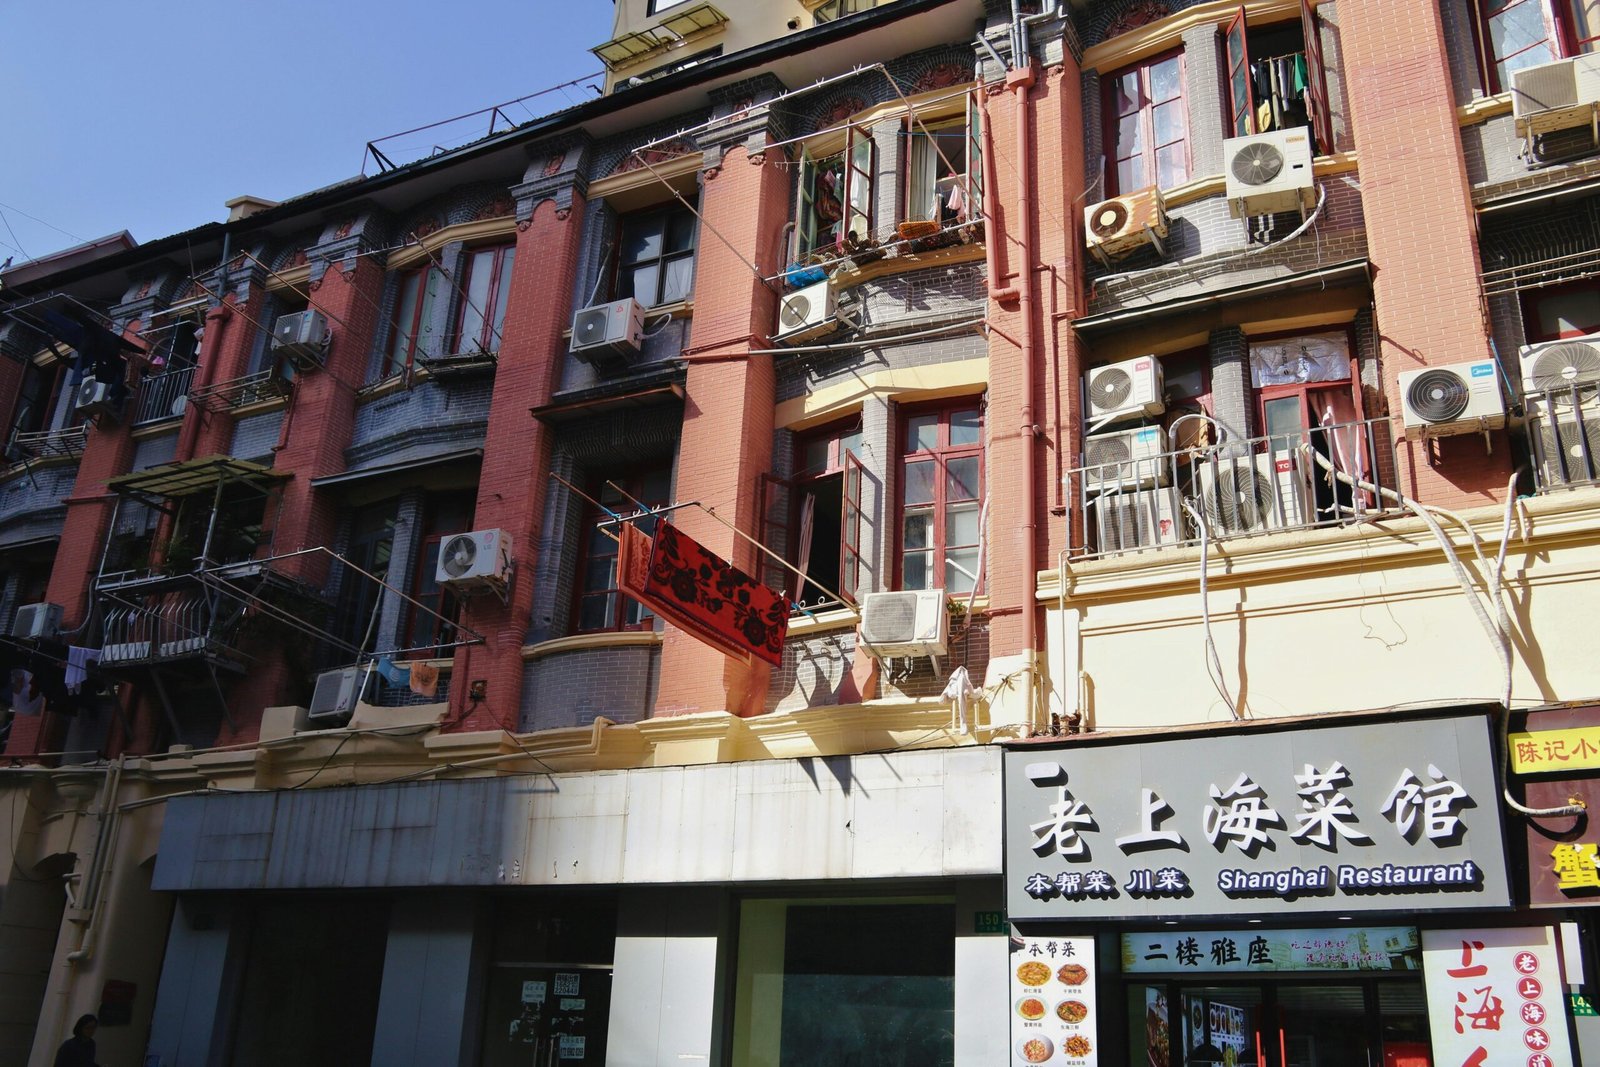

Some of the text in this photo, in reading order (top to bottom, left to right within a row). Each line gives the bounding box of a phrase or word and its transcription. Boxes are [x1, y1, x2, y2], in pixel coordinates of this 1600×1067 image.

[1516, 737, 1600, 764] 陈记小
[1025, 760, 1468, 855] 老上海菜馆
[1026, 869, 1185, 892] 本帮菜 川菜
[1220, 862, 1473, 890] Shanghai Restaurant
[977, 914, 999, 925] 150
[1029, 941, 1076, 958] 本帮菜
[1144, 936, 1274, 966] 二楼雅座
